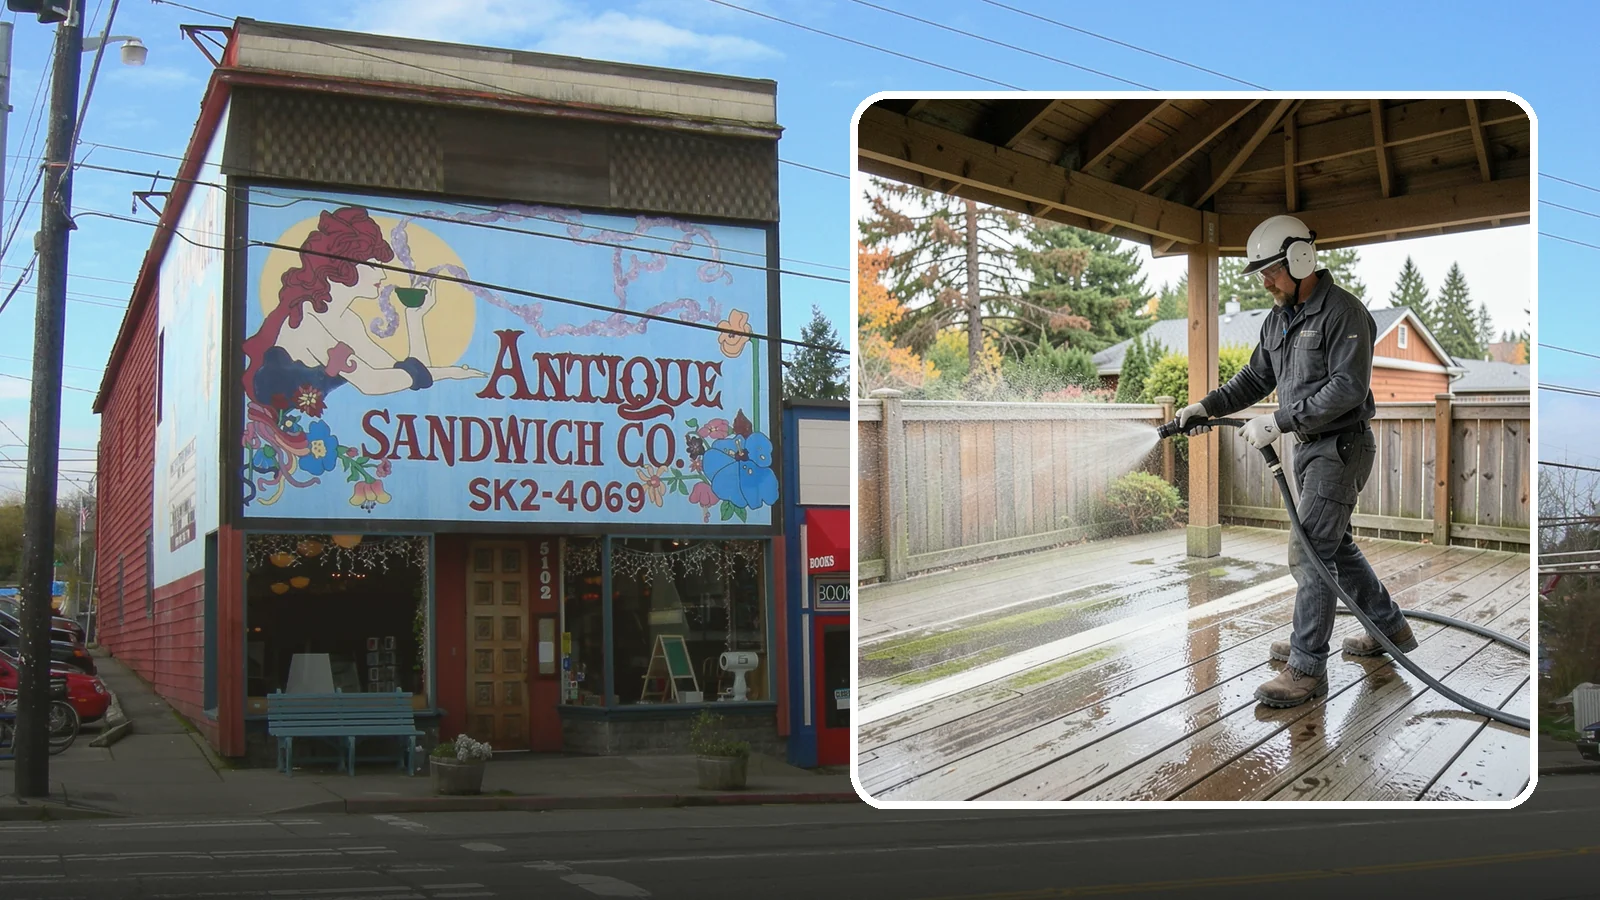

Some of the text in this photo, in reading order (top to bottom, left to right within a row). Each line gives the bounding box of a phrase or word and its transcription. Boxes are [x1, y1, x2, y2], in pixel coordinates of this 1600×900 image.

[475, 329, 723, 420] ANTIQUE
[361, 408, 685, 469] SANDWICH CO.
[468, 476, 646, 513] SK2-4069
[539, 542, 552, 599] 5102
[809, 555, 835, 569] BOOKS
